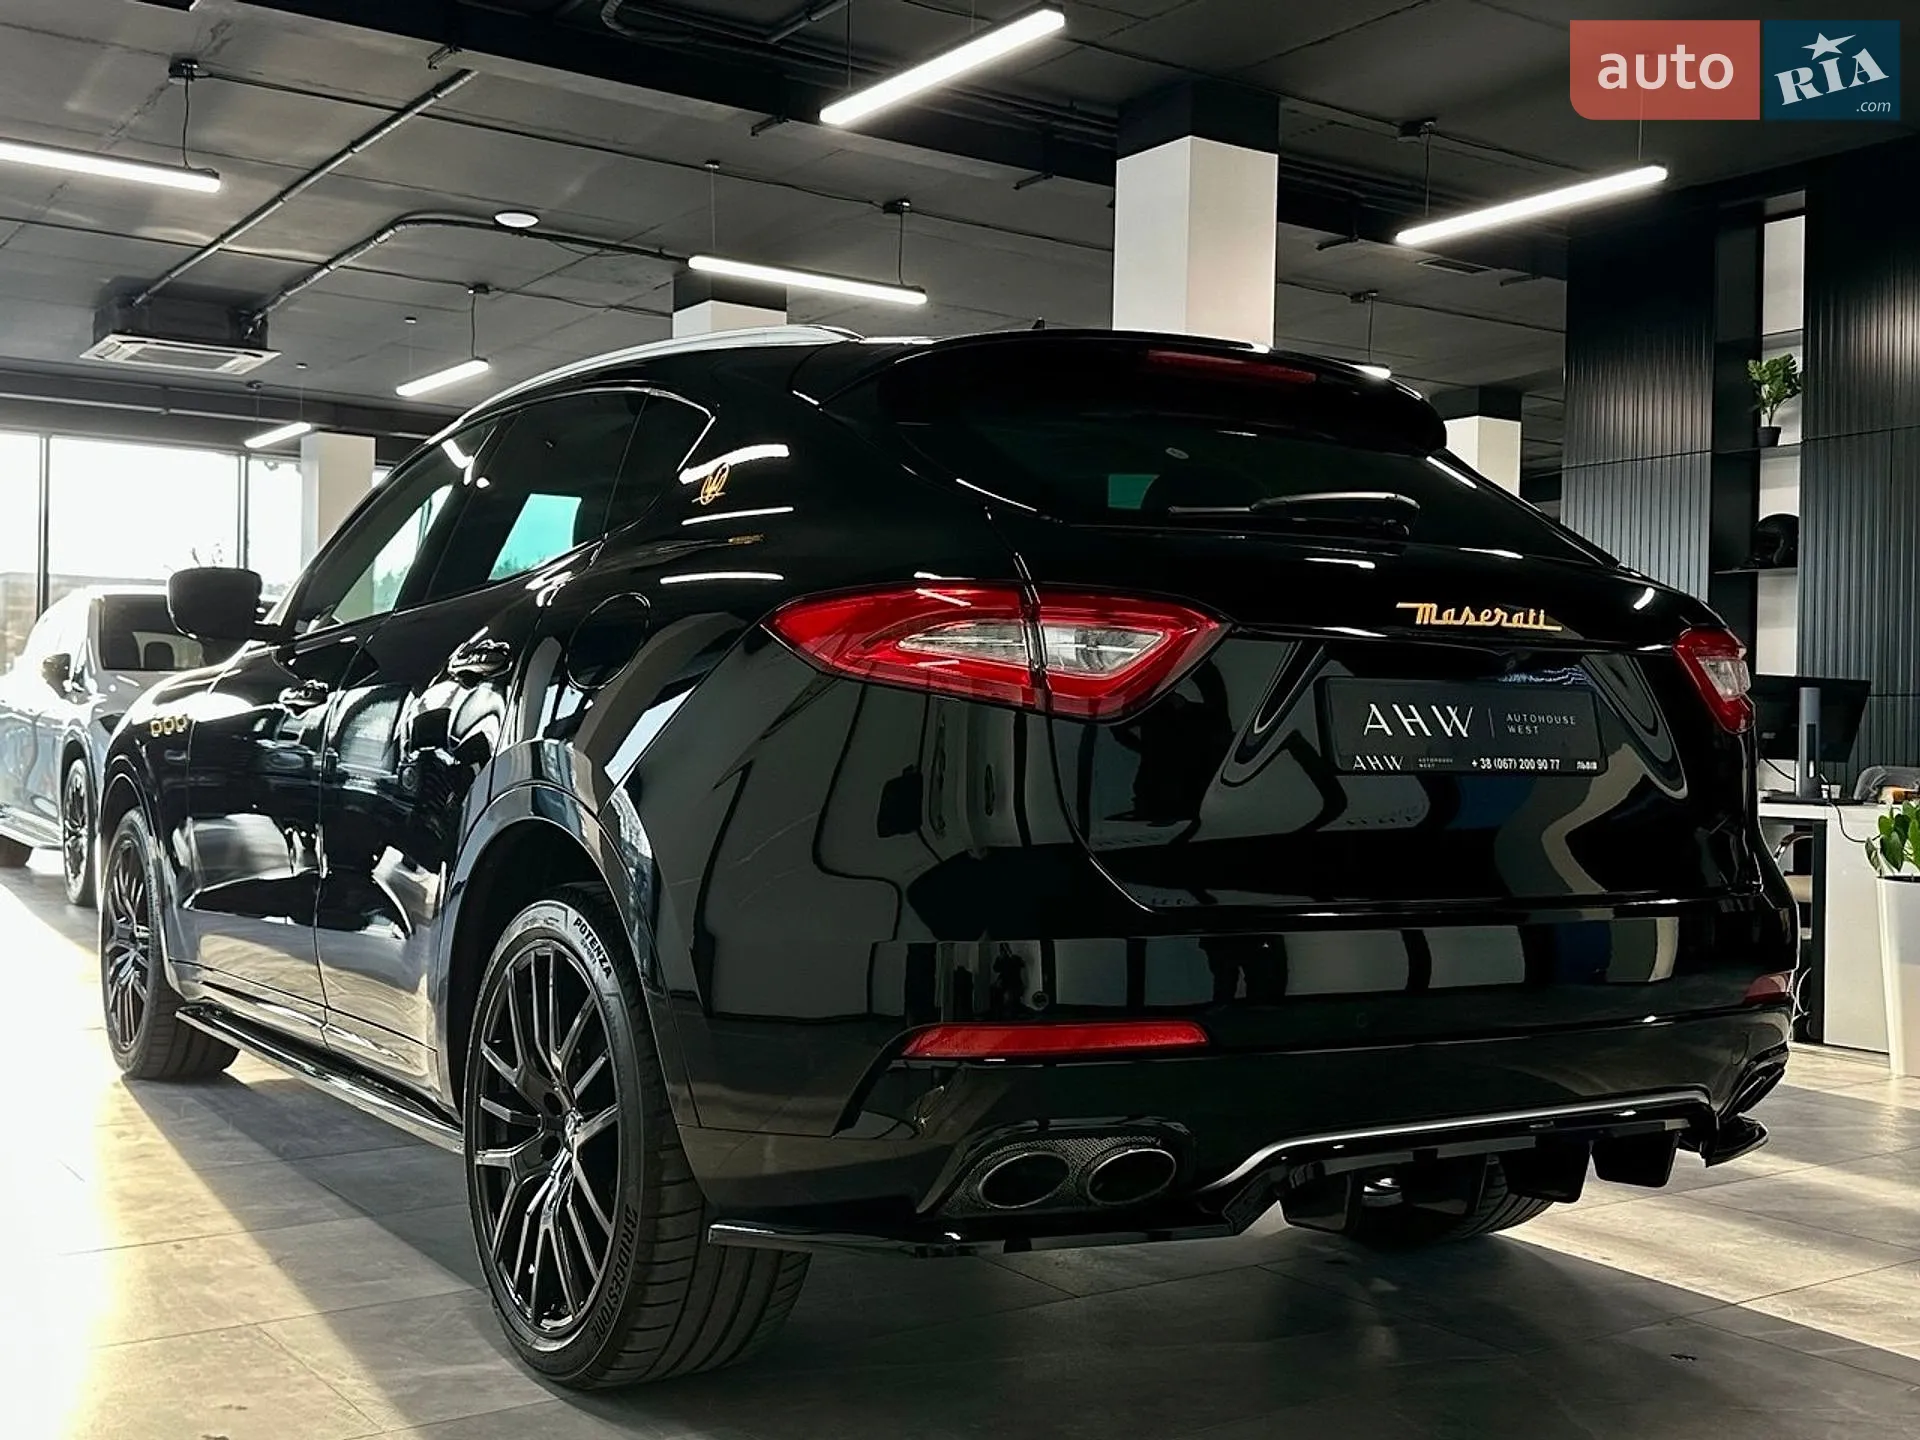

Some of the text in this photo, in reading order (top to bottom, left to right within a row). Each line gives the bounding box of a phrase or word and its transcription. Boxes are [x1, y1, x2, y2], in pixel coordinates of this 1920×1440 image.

[1396, 602, 1562, 631] Maserati
[1363, 703, 1474, 738] AHW
[1506, 713, 1576, 726] AUTOHOUSE
[1508, 725, 1539, 735] WEST
[1353, 755, 1403, 770] AHW
[1480, 758, 1492, 769] 38
[1493, 758, 1517, 769] (067)
[1519, 758, 1535, 769] 200
[1536, 759, 1548, 770] 90
[1550, 759, 1560, 770] 77
[573, 917, 614, 980] POTENZA
